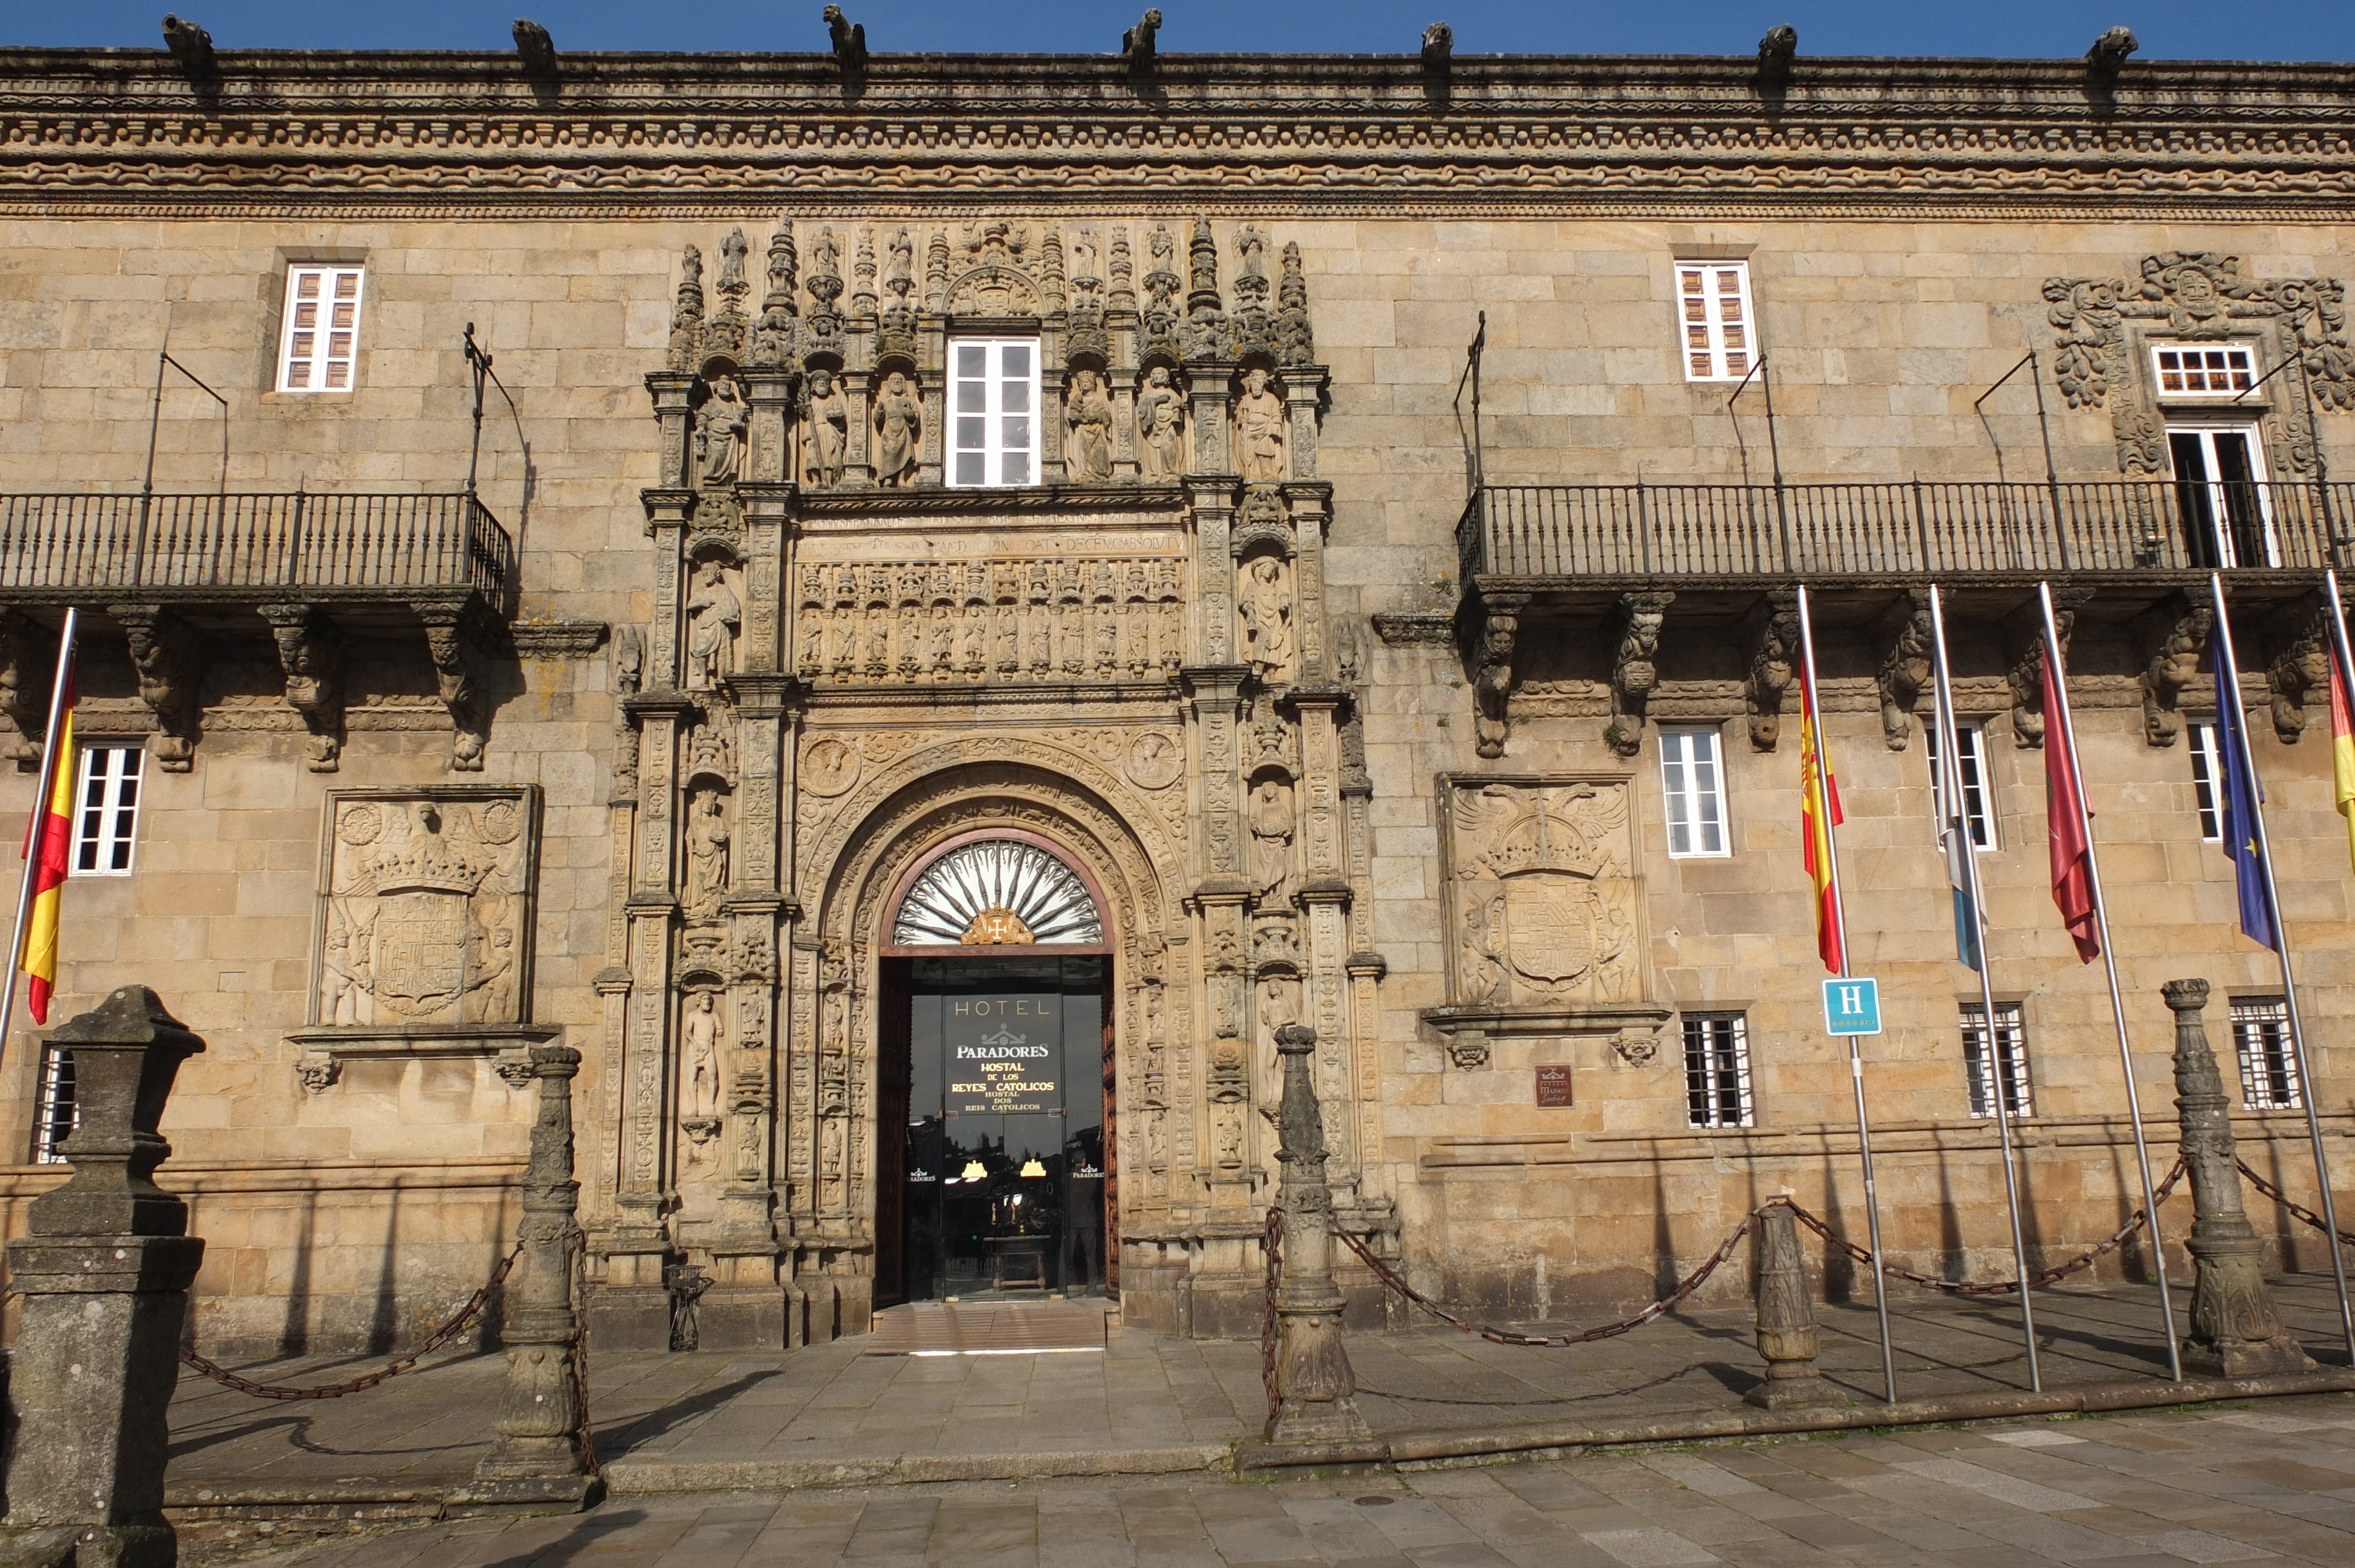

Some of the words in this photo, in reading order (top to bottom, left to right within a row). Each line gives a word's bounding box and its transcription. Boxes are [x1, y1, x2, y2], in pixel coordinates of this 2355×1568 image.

[1839, 986, 1863, 1014] H
[956, 1000, 1050, 1016] HOTEL
[956, 1044, 1049, 1058] PARADORES
[981, 1063, 1024, 1072] HOSTAL
[952, 1084, 986, 1092] REYES
[996, 1082, 1054, 1091] CATOLICOS
